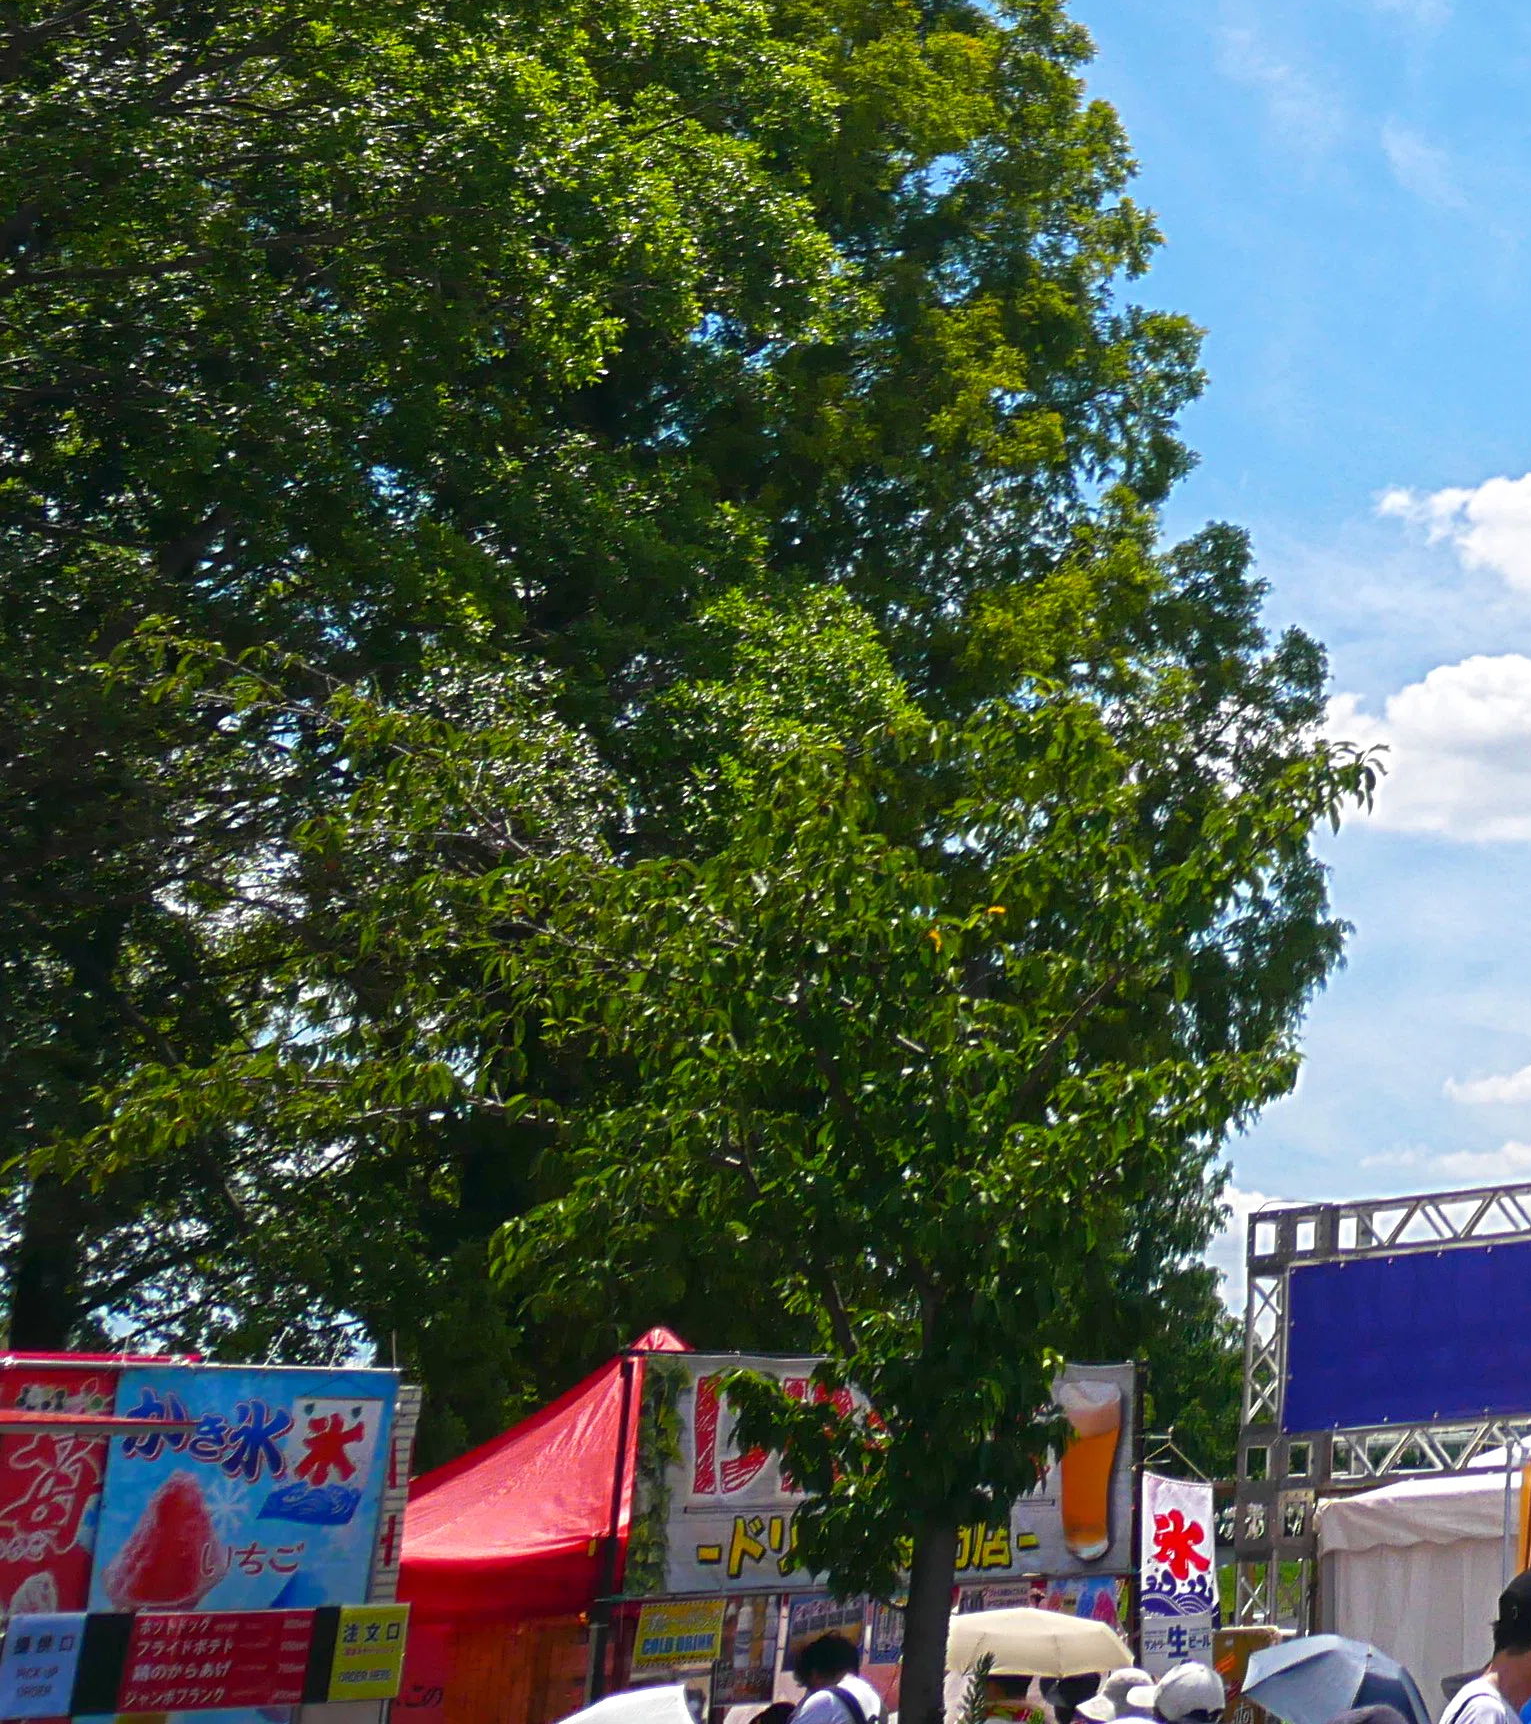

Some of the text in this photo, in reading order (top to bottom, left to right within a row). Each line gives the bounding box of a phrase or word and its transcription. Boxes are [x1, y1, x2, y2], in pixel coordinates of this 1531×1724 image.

[121, 1386, 294, 1484] かき氷
[295, 1413, 366, 1486] 氷
[201, 1542, 304, 1576] いちご
[1152, 1508, 1211, 1581] 氷
[136, 1637, 234, 1658] フライドポテト
[343, 1622, 400, 1643] 注文口
